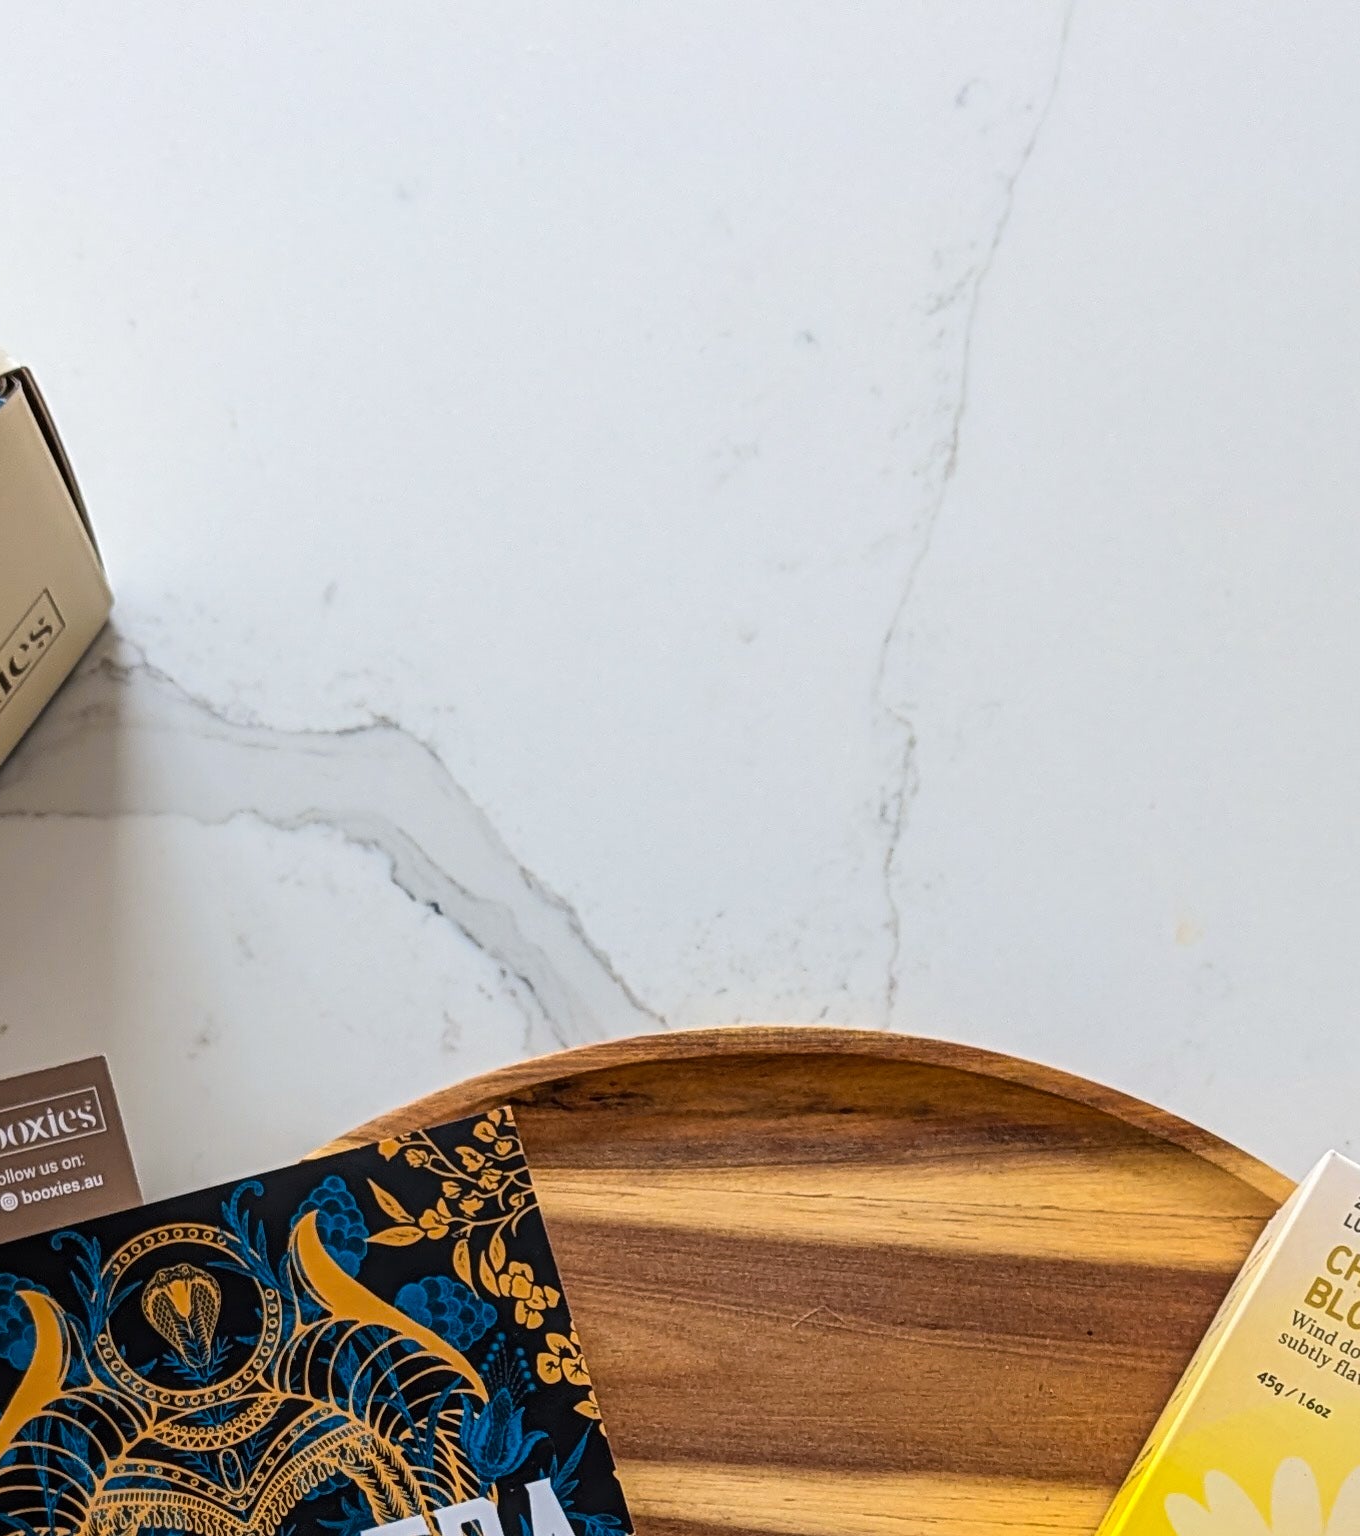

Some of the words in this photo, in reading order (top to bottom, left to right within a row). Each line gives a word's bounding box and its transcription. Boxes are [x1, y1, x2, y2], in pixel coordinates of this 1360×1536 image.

[39, 1161, 59, 1176] us
[61, 1153, 86, 1171] on:
[21, 1173, 104, 1204] booxies.au
[1291, 1309, 1339, 1347] Wind
[1278, 1332, 1333, 1369] subtly
[1257, 1372, 1285, 1396] 45g
[1284, 1387, 1299, 1398] /
[1297, 1392, 1332, 1419] 1.6oz
